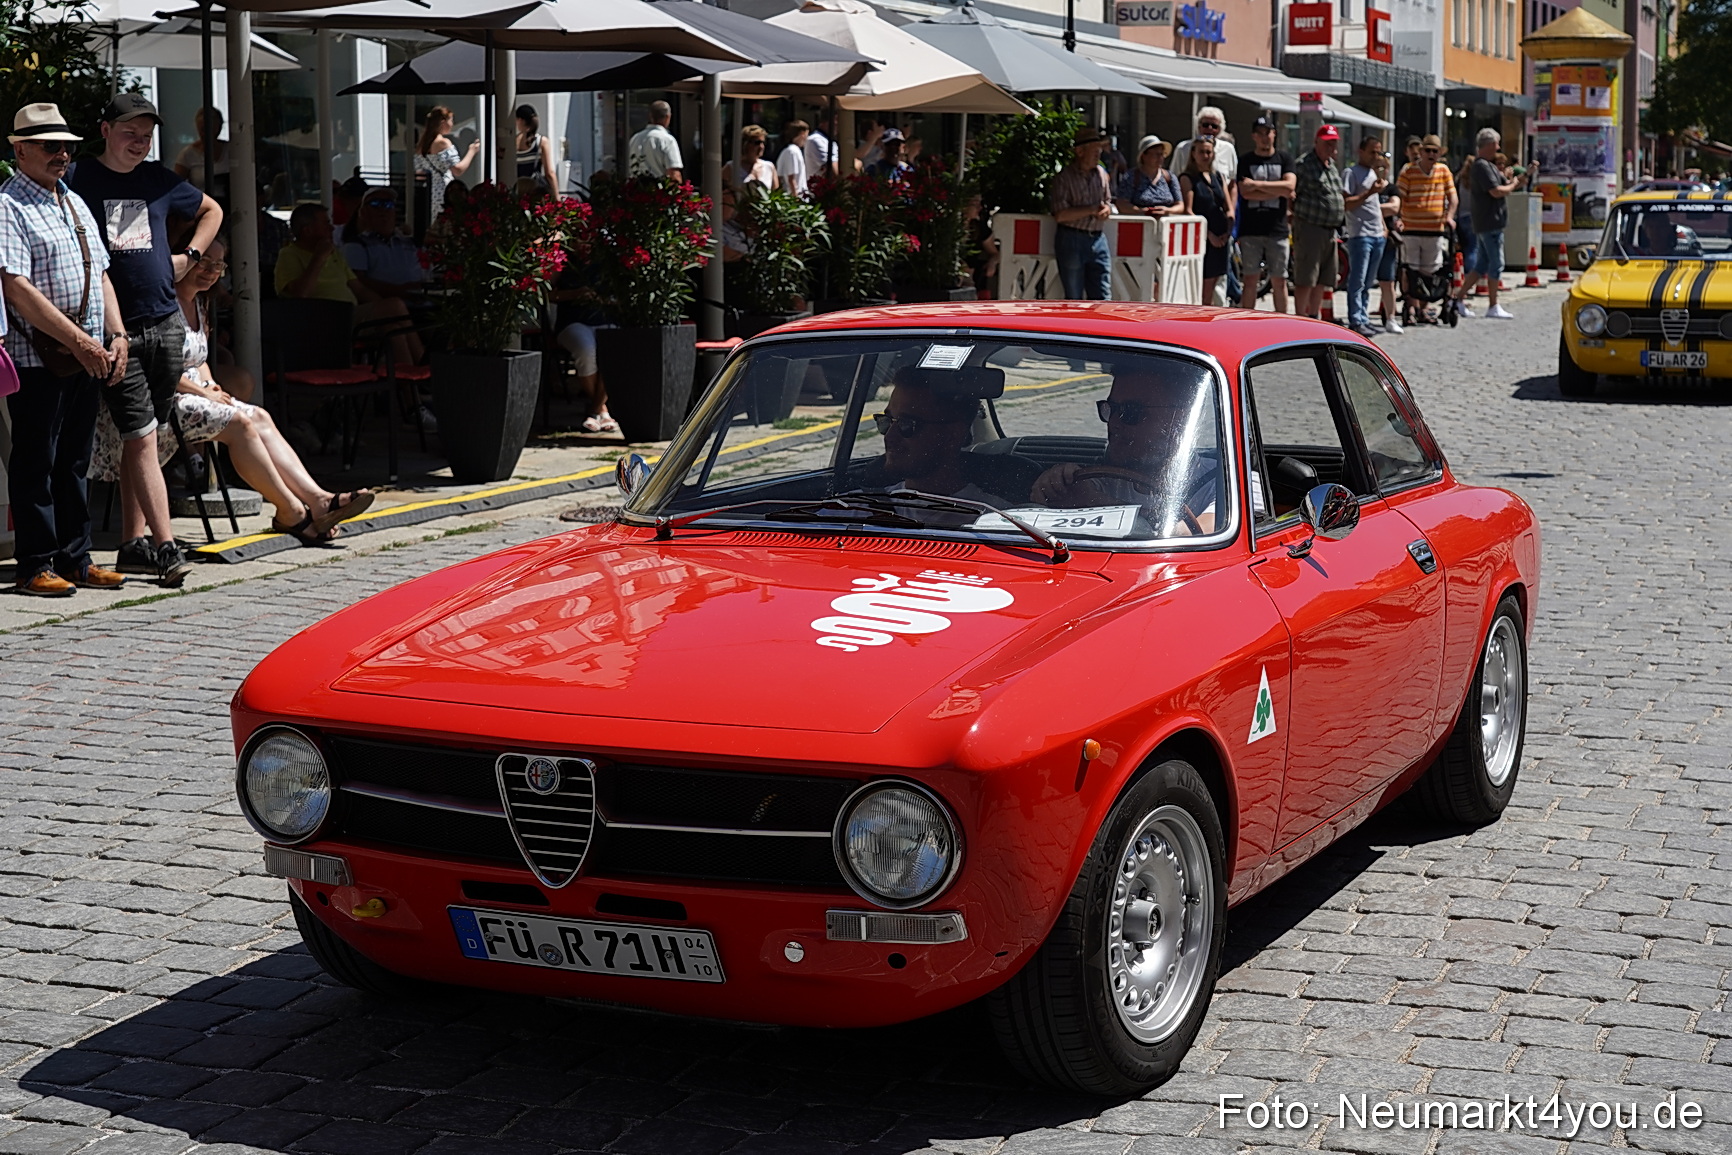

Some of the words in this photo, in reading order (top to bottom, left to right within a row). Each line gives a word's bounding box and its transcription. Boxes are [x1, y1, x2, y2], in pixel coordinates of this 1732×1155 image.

[1294, 16, 1325, 28] WITT
[1649, 352, 1664, 365] FÜ
[1673, 353, 1687, 366] AR
[1690, 353, 1705, 366] 26
[1052, 515, 1104, 528] 294
[467, 938, 477, 949] D
[479, 916, 538, 961] FÜ
[558, 925, 592, 966] R
[594, 929, 687, 975] 71H
[684, 937, 705, 949] 04
[693, 963, 713, 976] 10
